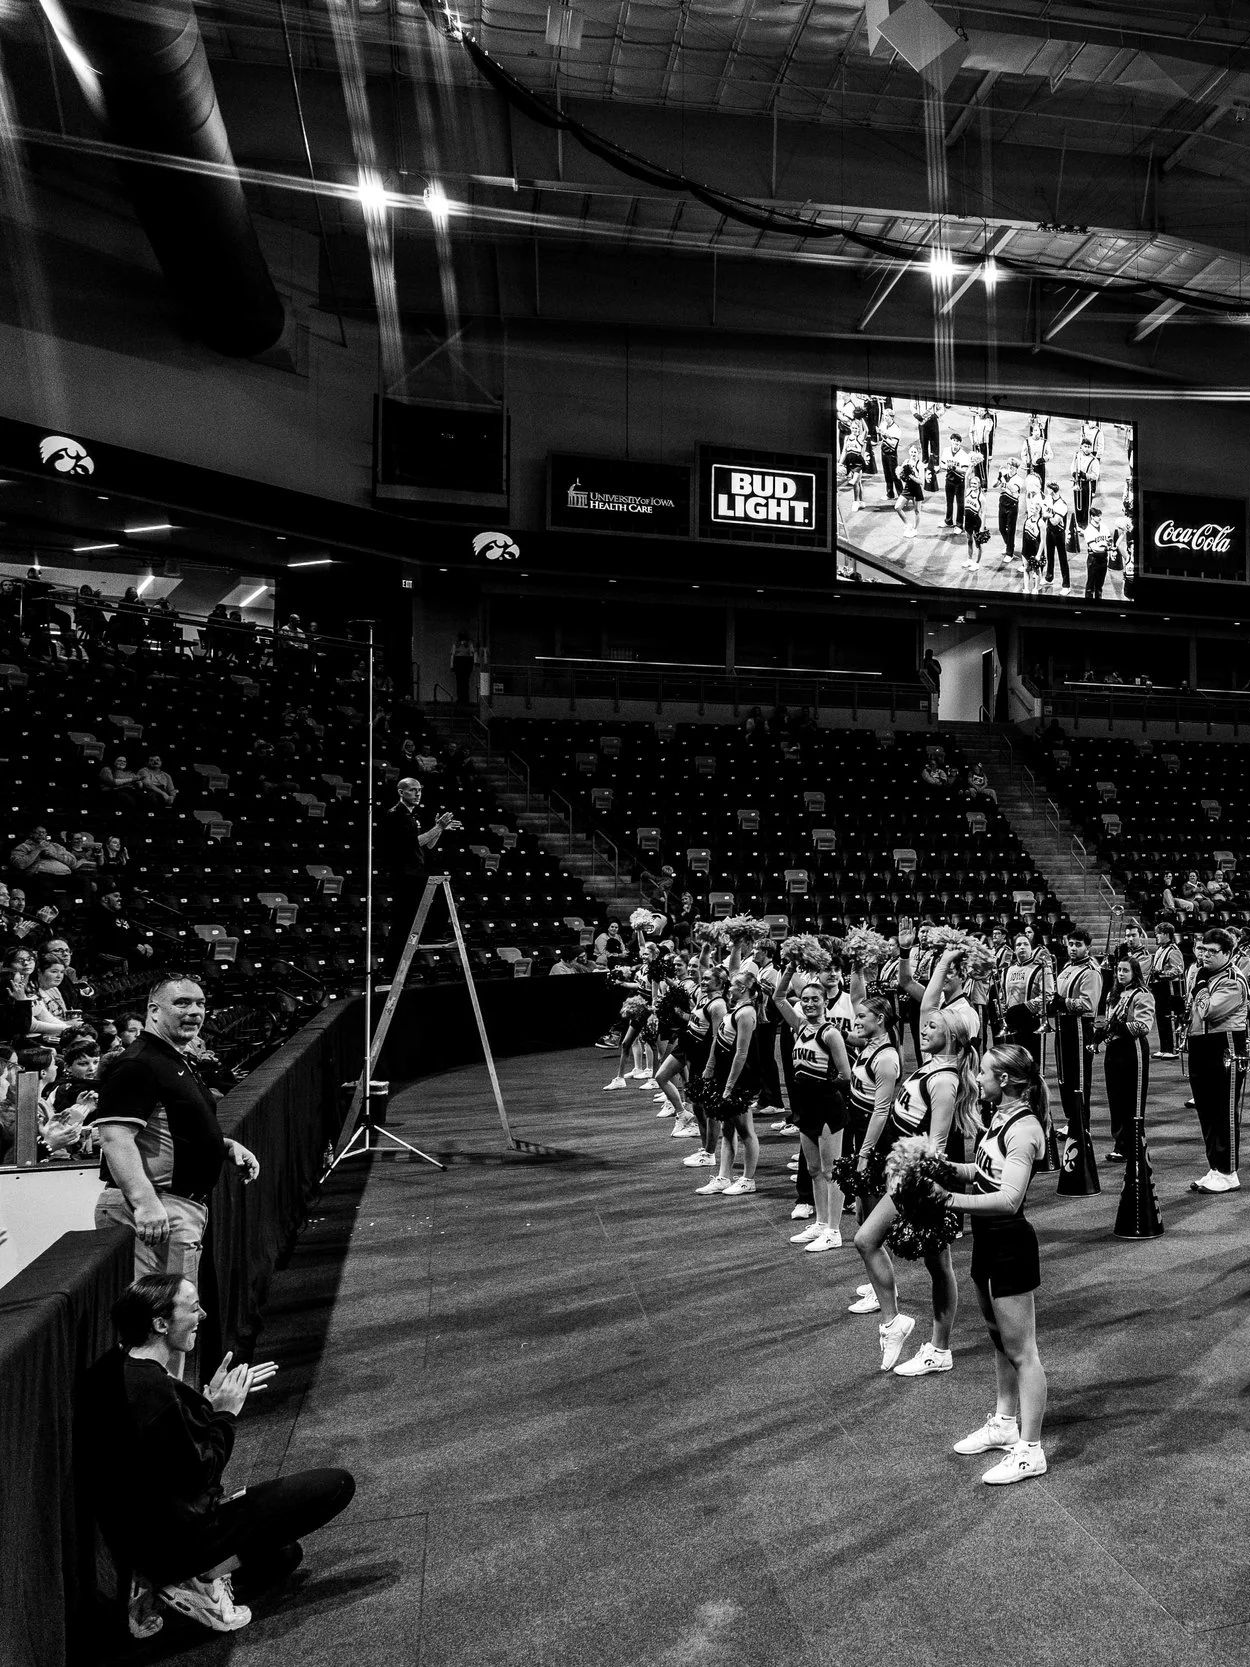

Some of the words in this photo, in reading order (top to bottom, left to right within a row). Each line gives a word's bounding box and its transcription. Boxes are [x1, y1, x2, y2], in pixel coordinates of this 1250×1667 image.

[731, 472, 797, 499] BUD
[589, 492, 641, 505] UNIVERSITY
[650, 497, 675, 507] IOWA
[589, 500, 627, 512] HEALTH
[628, 504, 653, 514] CARE
[1154, 520, 1235, 553] Coca-Cola
